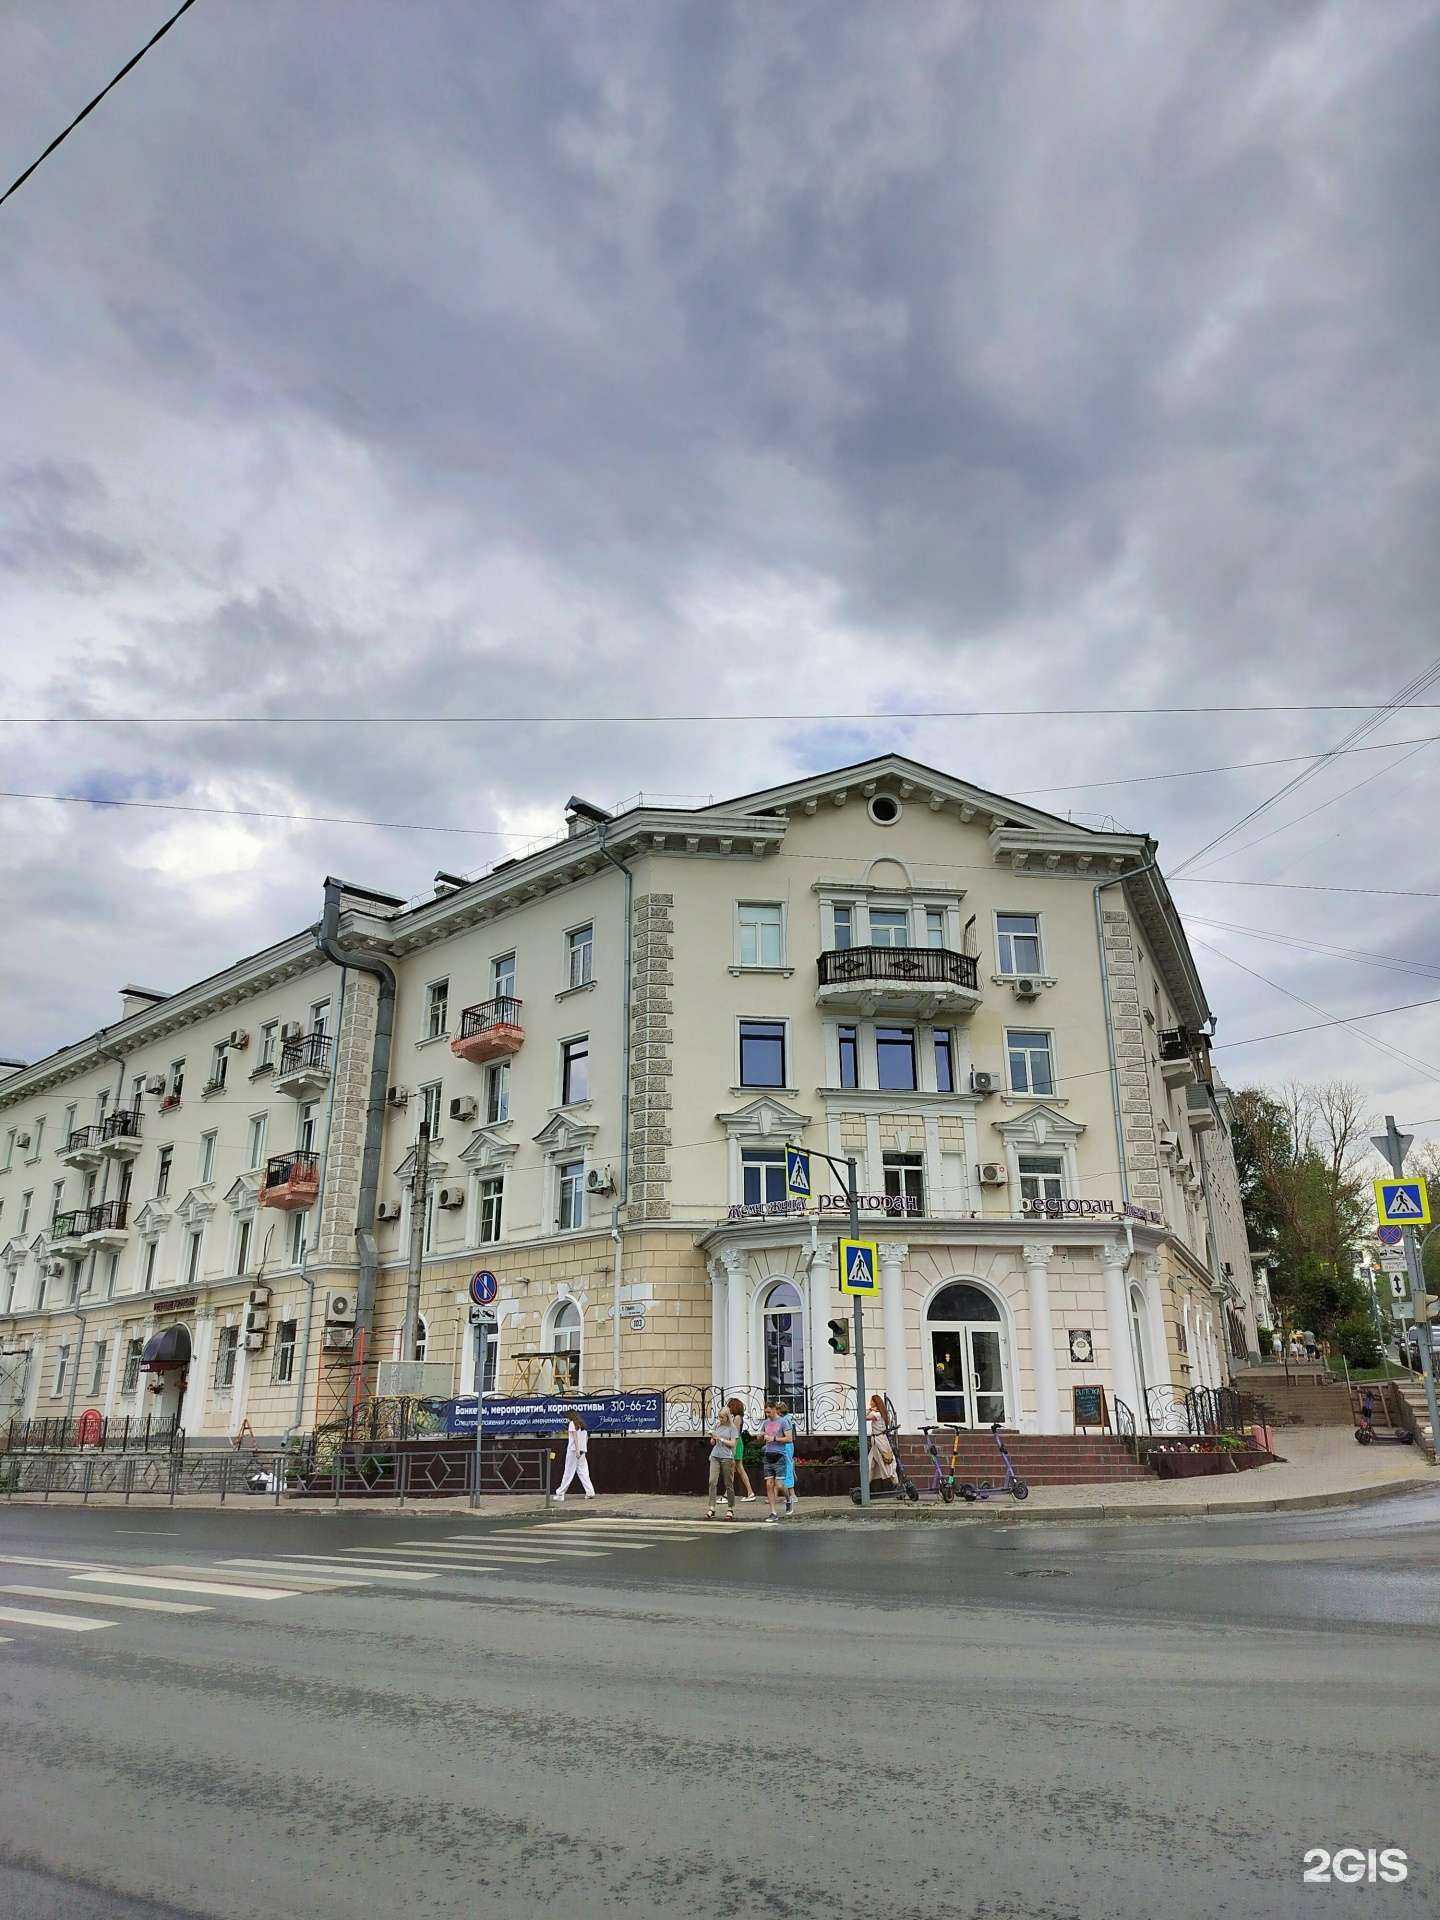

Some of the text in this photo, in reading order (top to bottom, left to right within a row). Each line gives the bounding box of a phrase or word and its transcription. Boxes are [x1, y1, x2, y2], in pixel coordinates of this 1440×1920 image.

[633, 1319, 643, 1328] 103
[455, 1405, 489, 1416] Банкеы,
[490, 1405, 546, 1416] мероприятия,
[610, 1399, 657, 1411] 310-66-23
